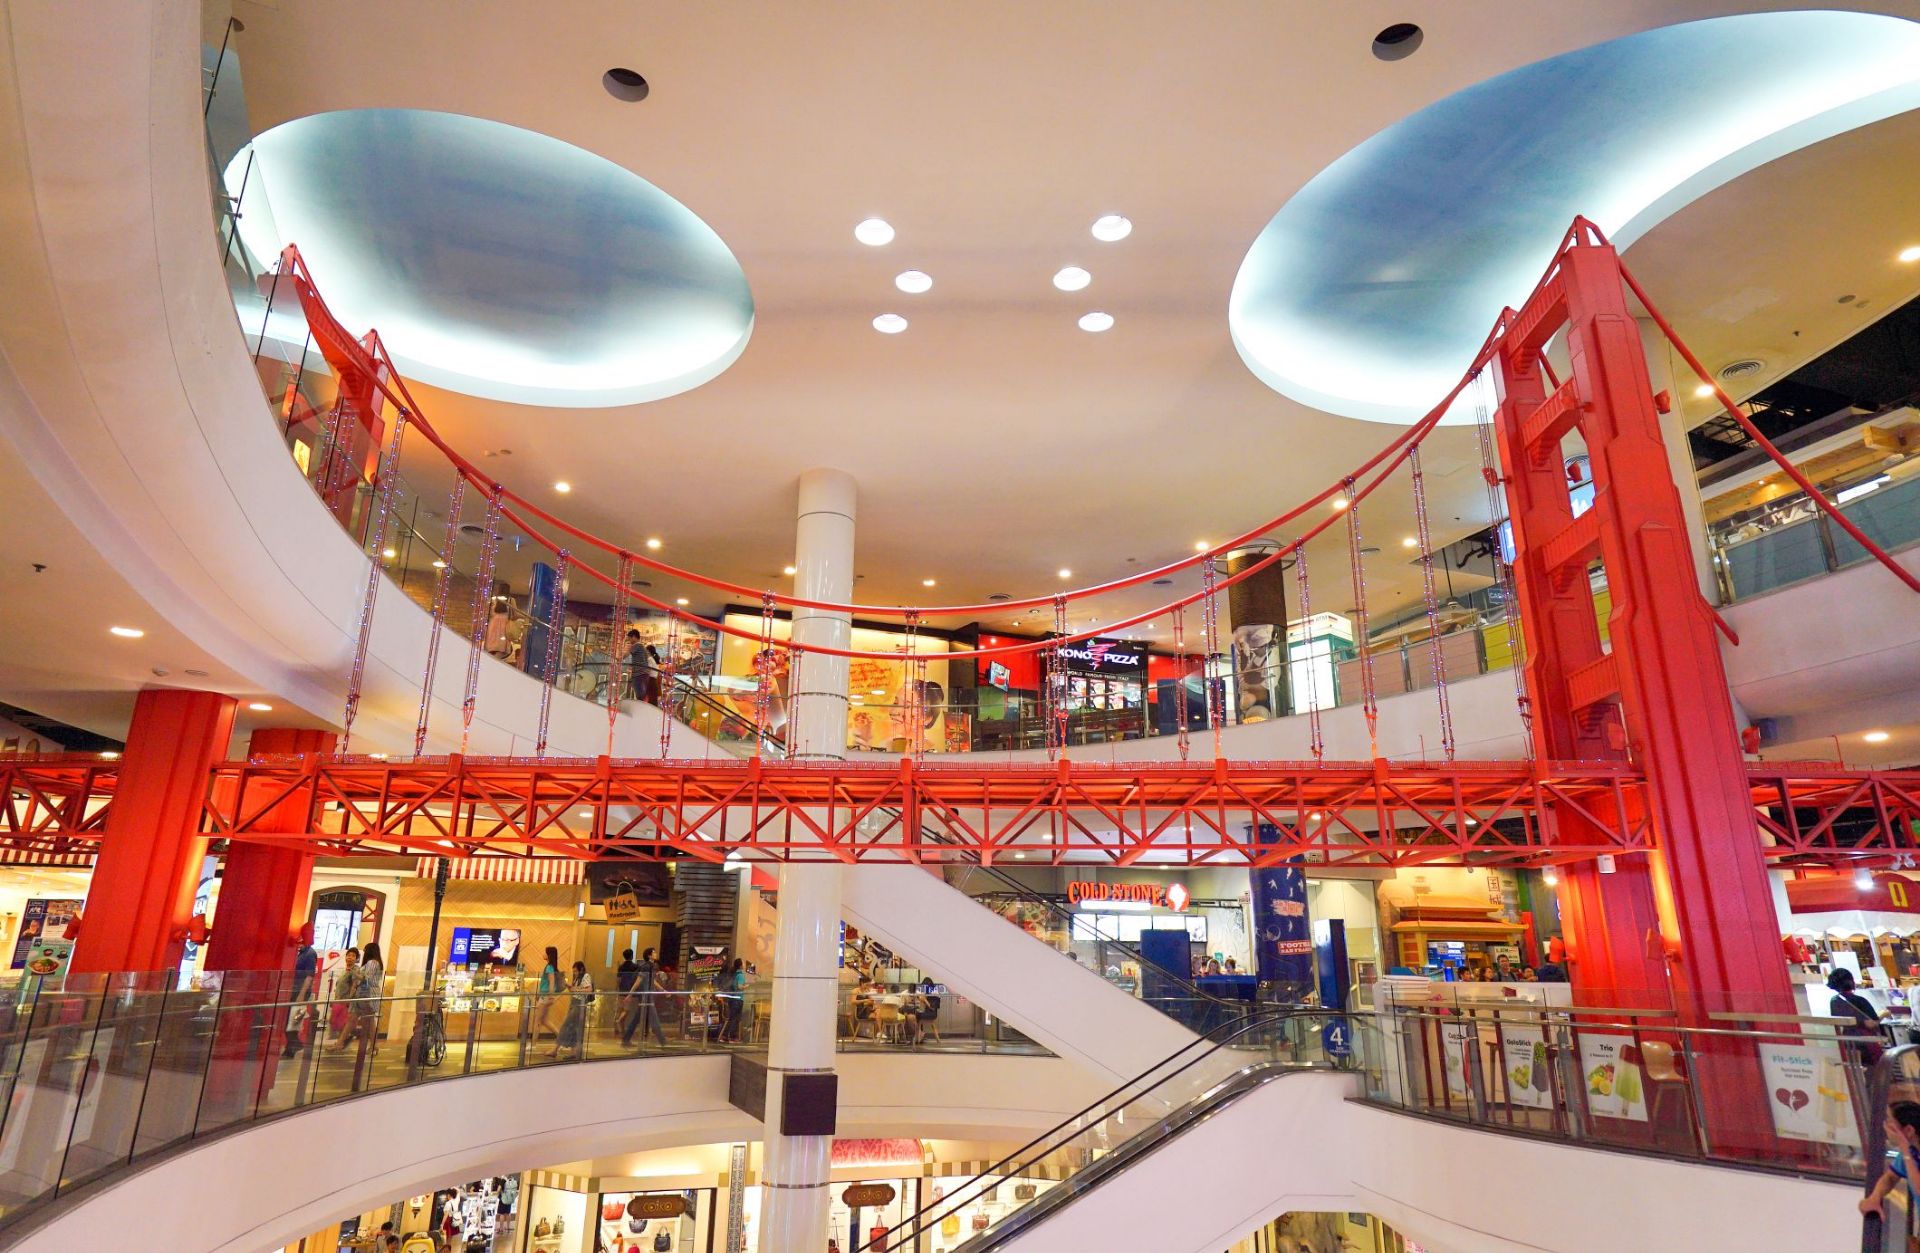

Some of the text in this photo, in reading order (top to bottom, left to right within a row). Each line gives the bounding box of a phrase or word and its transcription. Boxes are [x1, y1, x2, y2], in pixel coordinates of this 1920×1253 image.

[1057, 647, 1139, 665] KONO PIZZA
[1067, 881, 1162, 906] COLD STONE
[1330, 1027, 1343, 1045] 4
